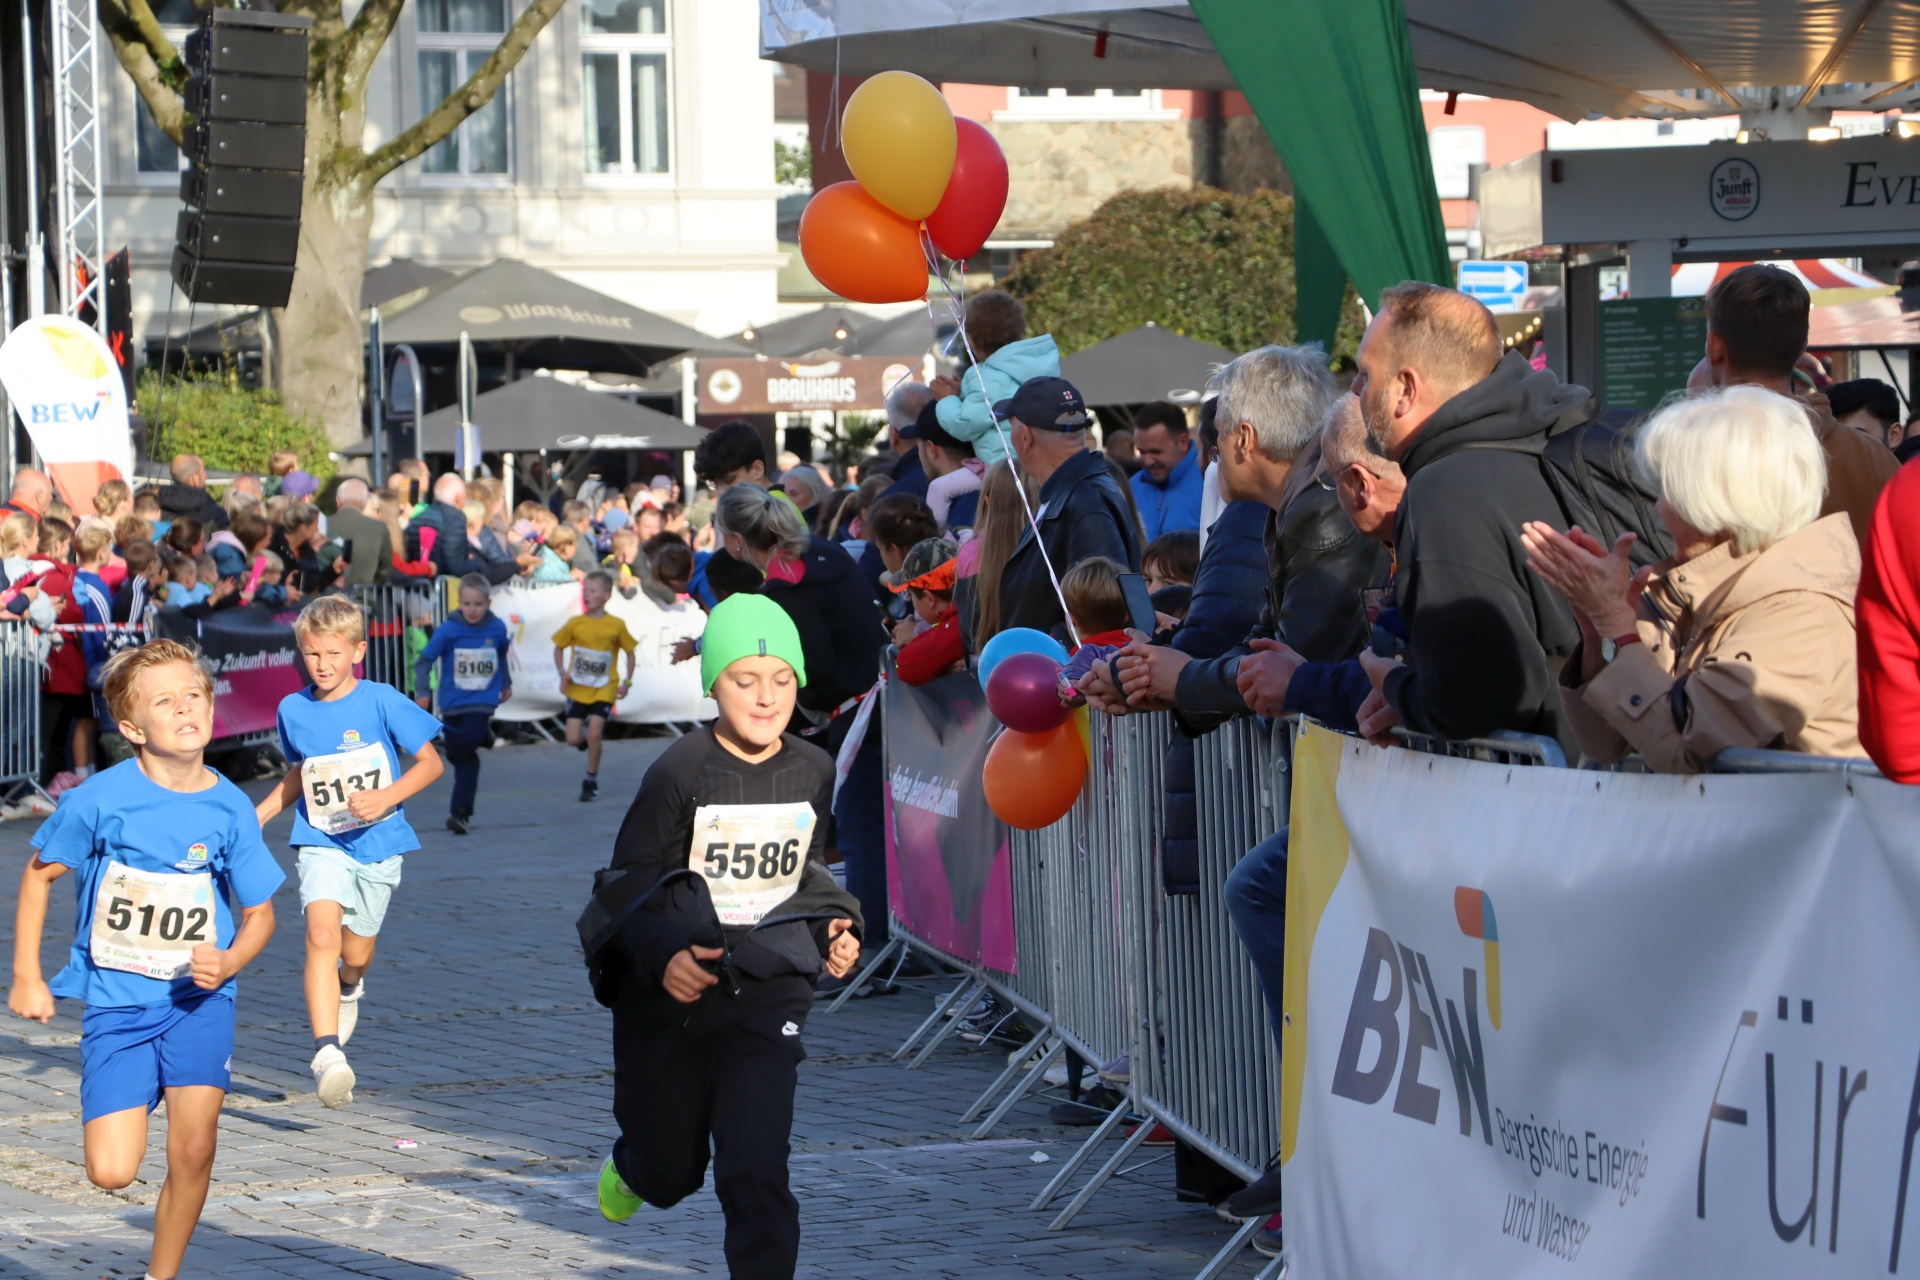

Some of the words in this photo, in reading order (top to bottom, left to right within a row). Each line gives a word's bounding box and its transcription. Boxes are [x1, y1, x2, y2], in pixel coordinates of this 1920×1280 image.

[503, 303, 633, 329] Warsteiner
[767, 377, 856, 403] BRAUHAUS
[31, 399, 101, 424] BEW
[220, 649, 267, 672] Zukunft
[268, 647, 295, 668] voller
[458, 661, 494, 674] 5109
[312, 768, 381, 806] 5137
[704, 838, 800, 880] 5586
[107, 896, 208, 941] 5102
[723, 912, 752, 921] VOSS
[122, 962, 149, 973] VOSS
[150, 968, 173, 977] BEW
[1331, 926, 1493, 1147] BEW
[1697, 995, 1867, 1254] Für
[1495, 1106, 1579, 1179] Bergische
[1585, 1131, 1649, 1208] Energie
[1502, 1190, 1537, 1244] und
[1537, 1197, 1592, 1264] Wasser
